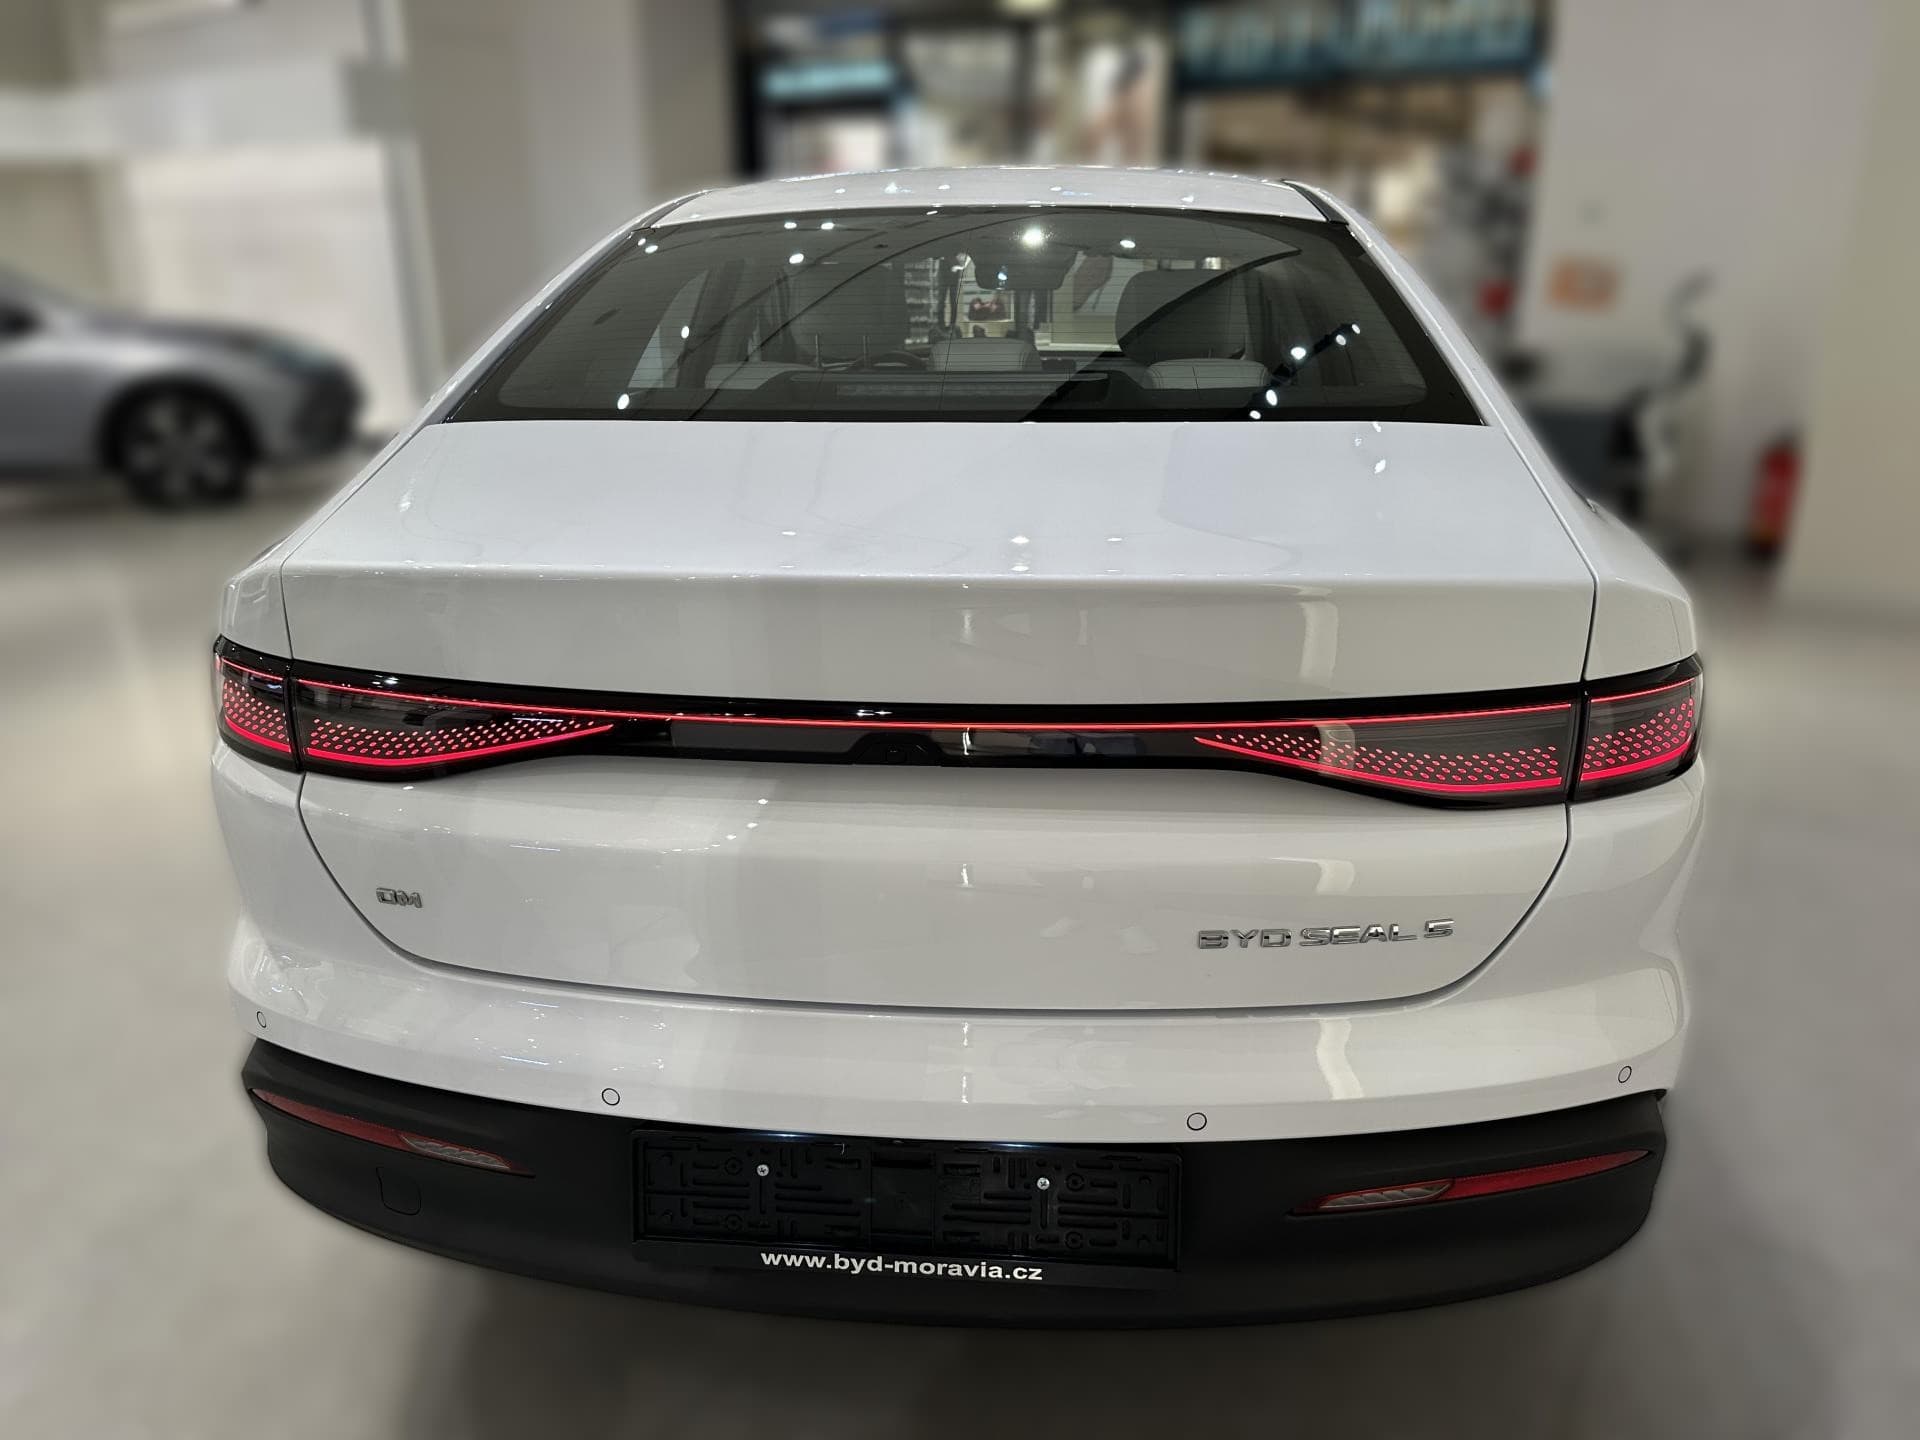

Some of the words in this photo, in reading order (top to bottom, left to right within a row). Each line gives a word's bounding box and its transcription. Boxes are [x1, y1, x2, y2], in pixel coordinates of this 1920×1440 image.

[376, 887, 422, 908] DM
[1199, 929, 1292, 949] BYD
[1299, 924, 1418, 946] SEAL
[1423, 918, 1454, 938] 5
[760, 1252, 1043, 1281] www.byd-moravia.cz
